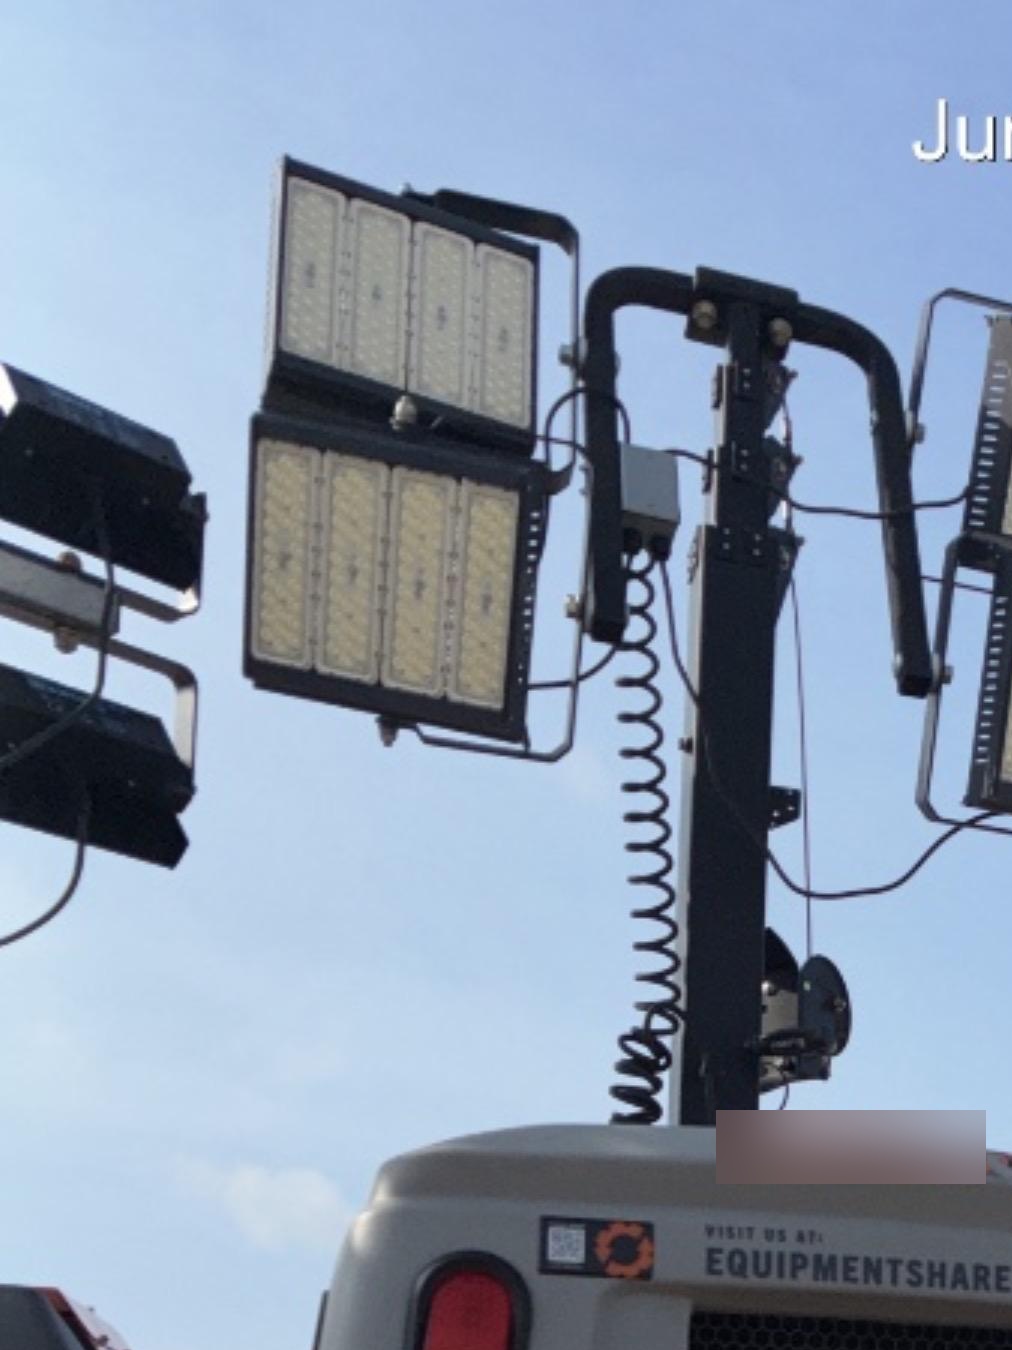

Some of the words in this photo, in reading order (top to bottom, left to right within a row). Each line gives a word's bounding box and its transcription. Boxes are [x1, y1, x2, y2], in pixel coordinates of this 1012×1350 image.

[704, 1224, 756, 1241] VISIT
[764, 1229, 788, 1243] US
[796, 1229, 823, 1245] AT:
